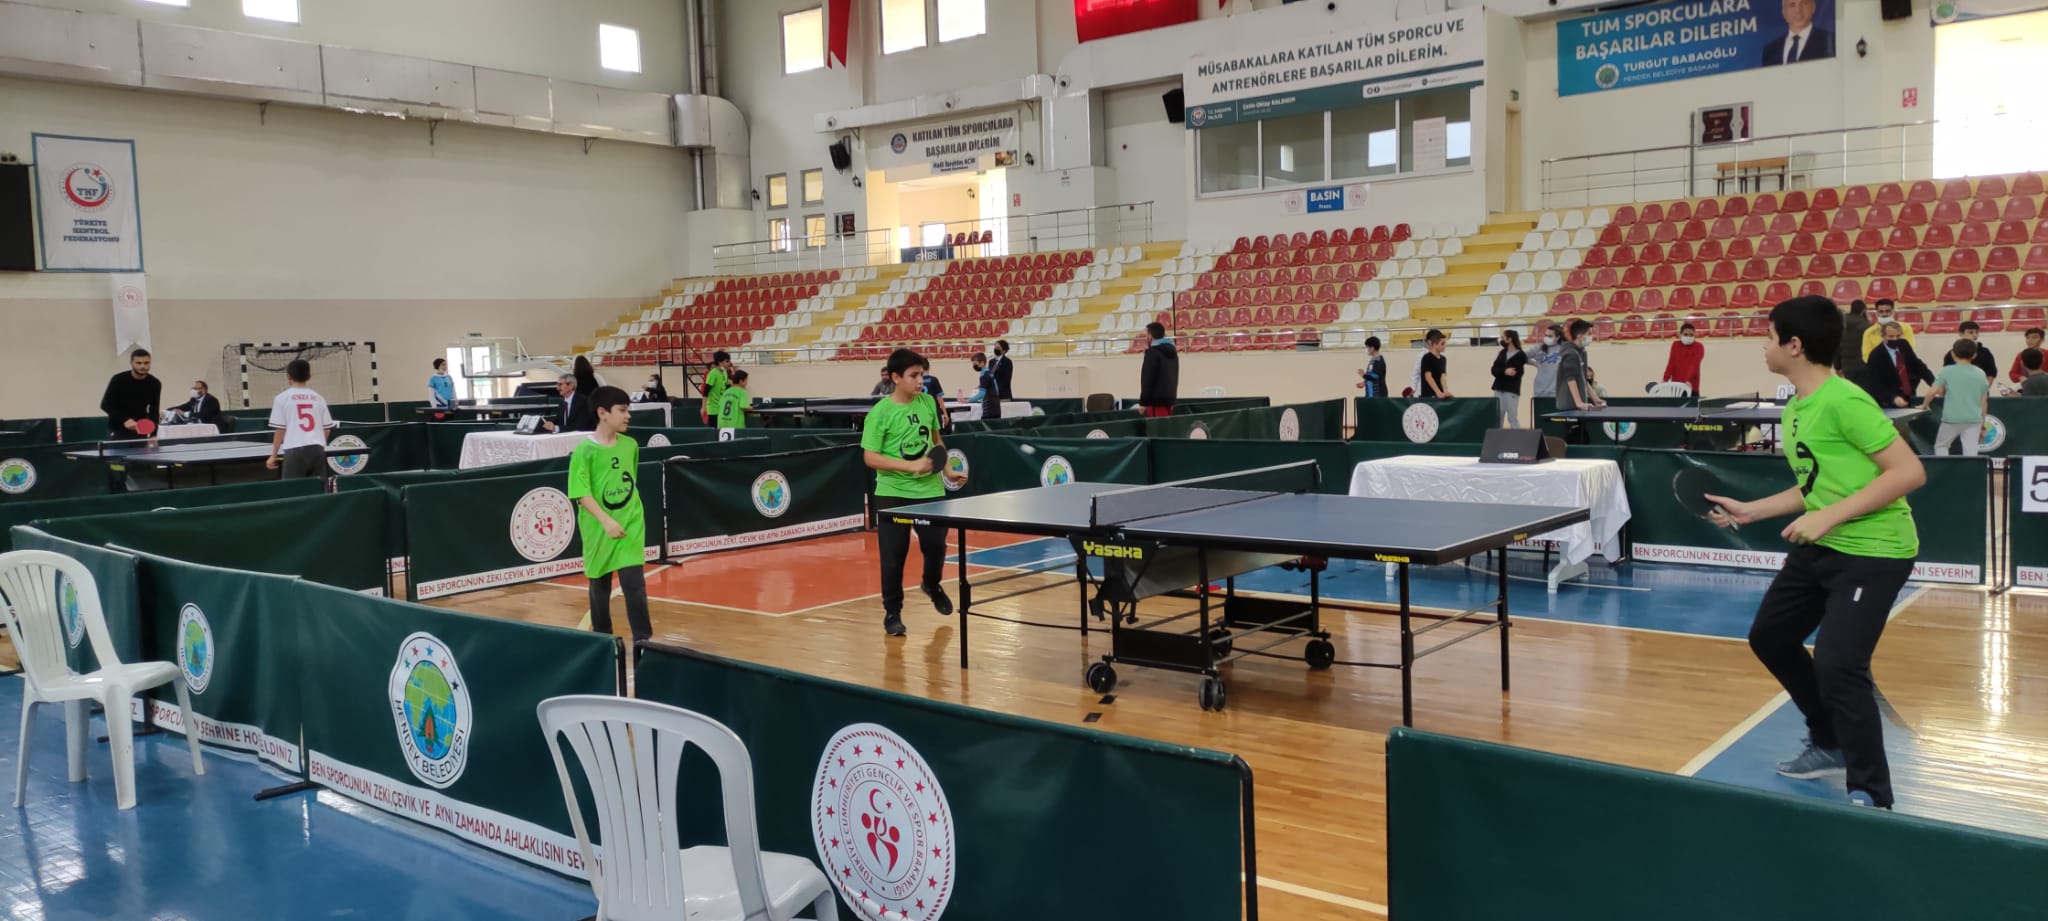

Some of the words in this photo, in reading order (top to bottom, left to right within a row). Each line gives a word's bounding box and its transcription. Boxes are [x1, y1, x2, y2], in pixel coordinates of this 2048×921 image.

[1624, 0, 1751, 29] SPORCULARA
[1198, 51, 1295, 77] MÜSABAKALARA
[1298, 40, 1353, 60] KATILAN
[1356, 32, 1385, 49] TÜM
[1388, 22, 1443, 44] SPORCU
[1446, 18, 1465, 33] VE
[1575, 28, 1675, 61] BAŞARILAR
[1680, 16, 1758, 45] DİLERİM
[1212, 67, 1307, 94] ANTRENÖRLERE
[1310, 56, 1383, 79] BAŞARILAR
[1386, 44, 1448, 65] DİLERİM.
[1623, 57, 1668, 73] TURGUT
[1671, 46, 1738, 66] BABAOĞLU
[912, 128, 943, 143] KATILAN
[943, 125, 961, 138] TÜM
[962, 117, 1014, 135] SPORCULARA
[925, 141, 968, 158] BAŞARILAR
[968, 135, 1001, 151] DİLERİM
[76, 187, 99, 197] THF
[1310, 189, 1340, 202] BASIN
[63, 234, 120, 244] FEDERASYONU
[296, 403, 316, 432] 5
[907, 413, 920, 425] 14
[1684, 423, 1724, 432] Yasaka
[1792, 418, 1798, 437] 5
[611, 456, 620, 469] 2
[2030, 465, 2048, 502] 5
[1083, 539, 1143, 560] Yasaka
[1374, 553, 1410, 563] Yasaka
[1633, 546, 1650, 557] BEN
[1651, 547, 1710, 561] SPORCUNUN
[1765, 555, 1777, 566] VE
[419, 583, 435, 596] BEN
[436, 575, 485, 593] SPORCUNUN
[525, 566, 535, 577] VE
[537, 564, 554, 575] AYNI
[555, 559, 585, 572] ZAMAND
[2020, 570, 2043, 581] BEN
[394, 699, 421, 768] HENDEK
[421, 727, 465, 778] BELEDİYESİ
[866, 768, 904, 794] GENÇLİK
[311, 760, 327, 778] BEN
[326, 766, 372, 797] SPORCUNUN
[418, 799, 430, 817] VE
[434, 802, 454, 825] AYNI
[454, 811, 502, 842] ZAMANDA
[504, 827, 564, 866] AHLAKLISINI
[842, 767, 866, 836] CUMHURİYETİ
[903, 792, 915, 809] VE
[911, 812, 925, 847] SPOR
[844, 838, 874, 885] TÜRKİYE
[893, 850, 924, 896] BAKANLIĞI
